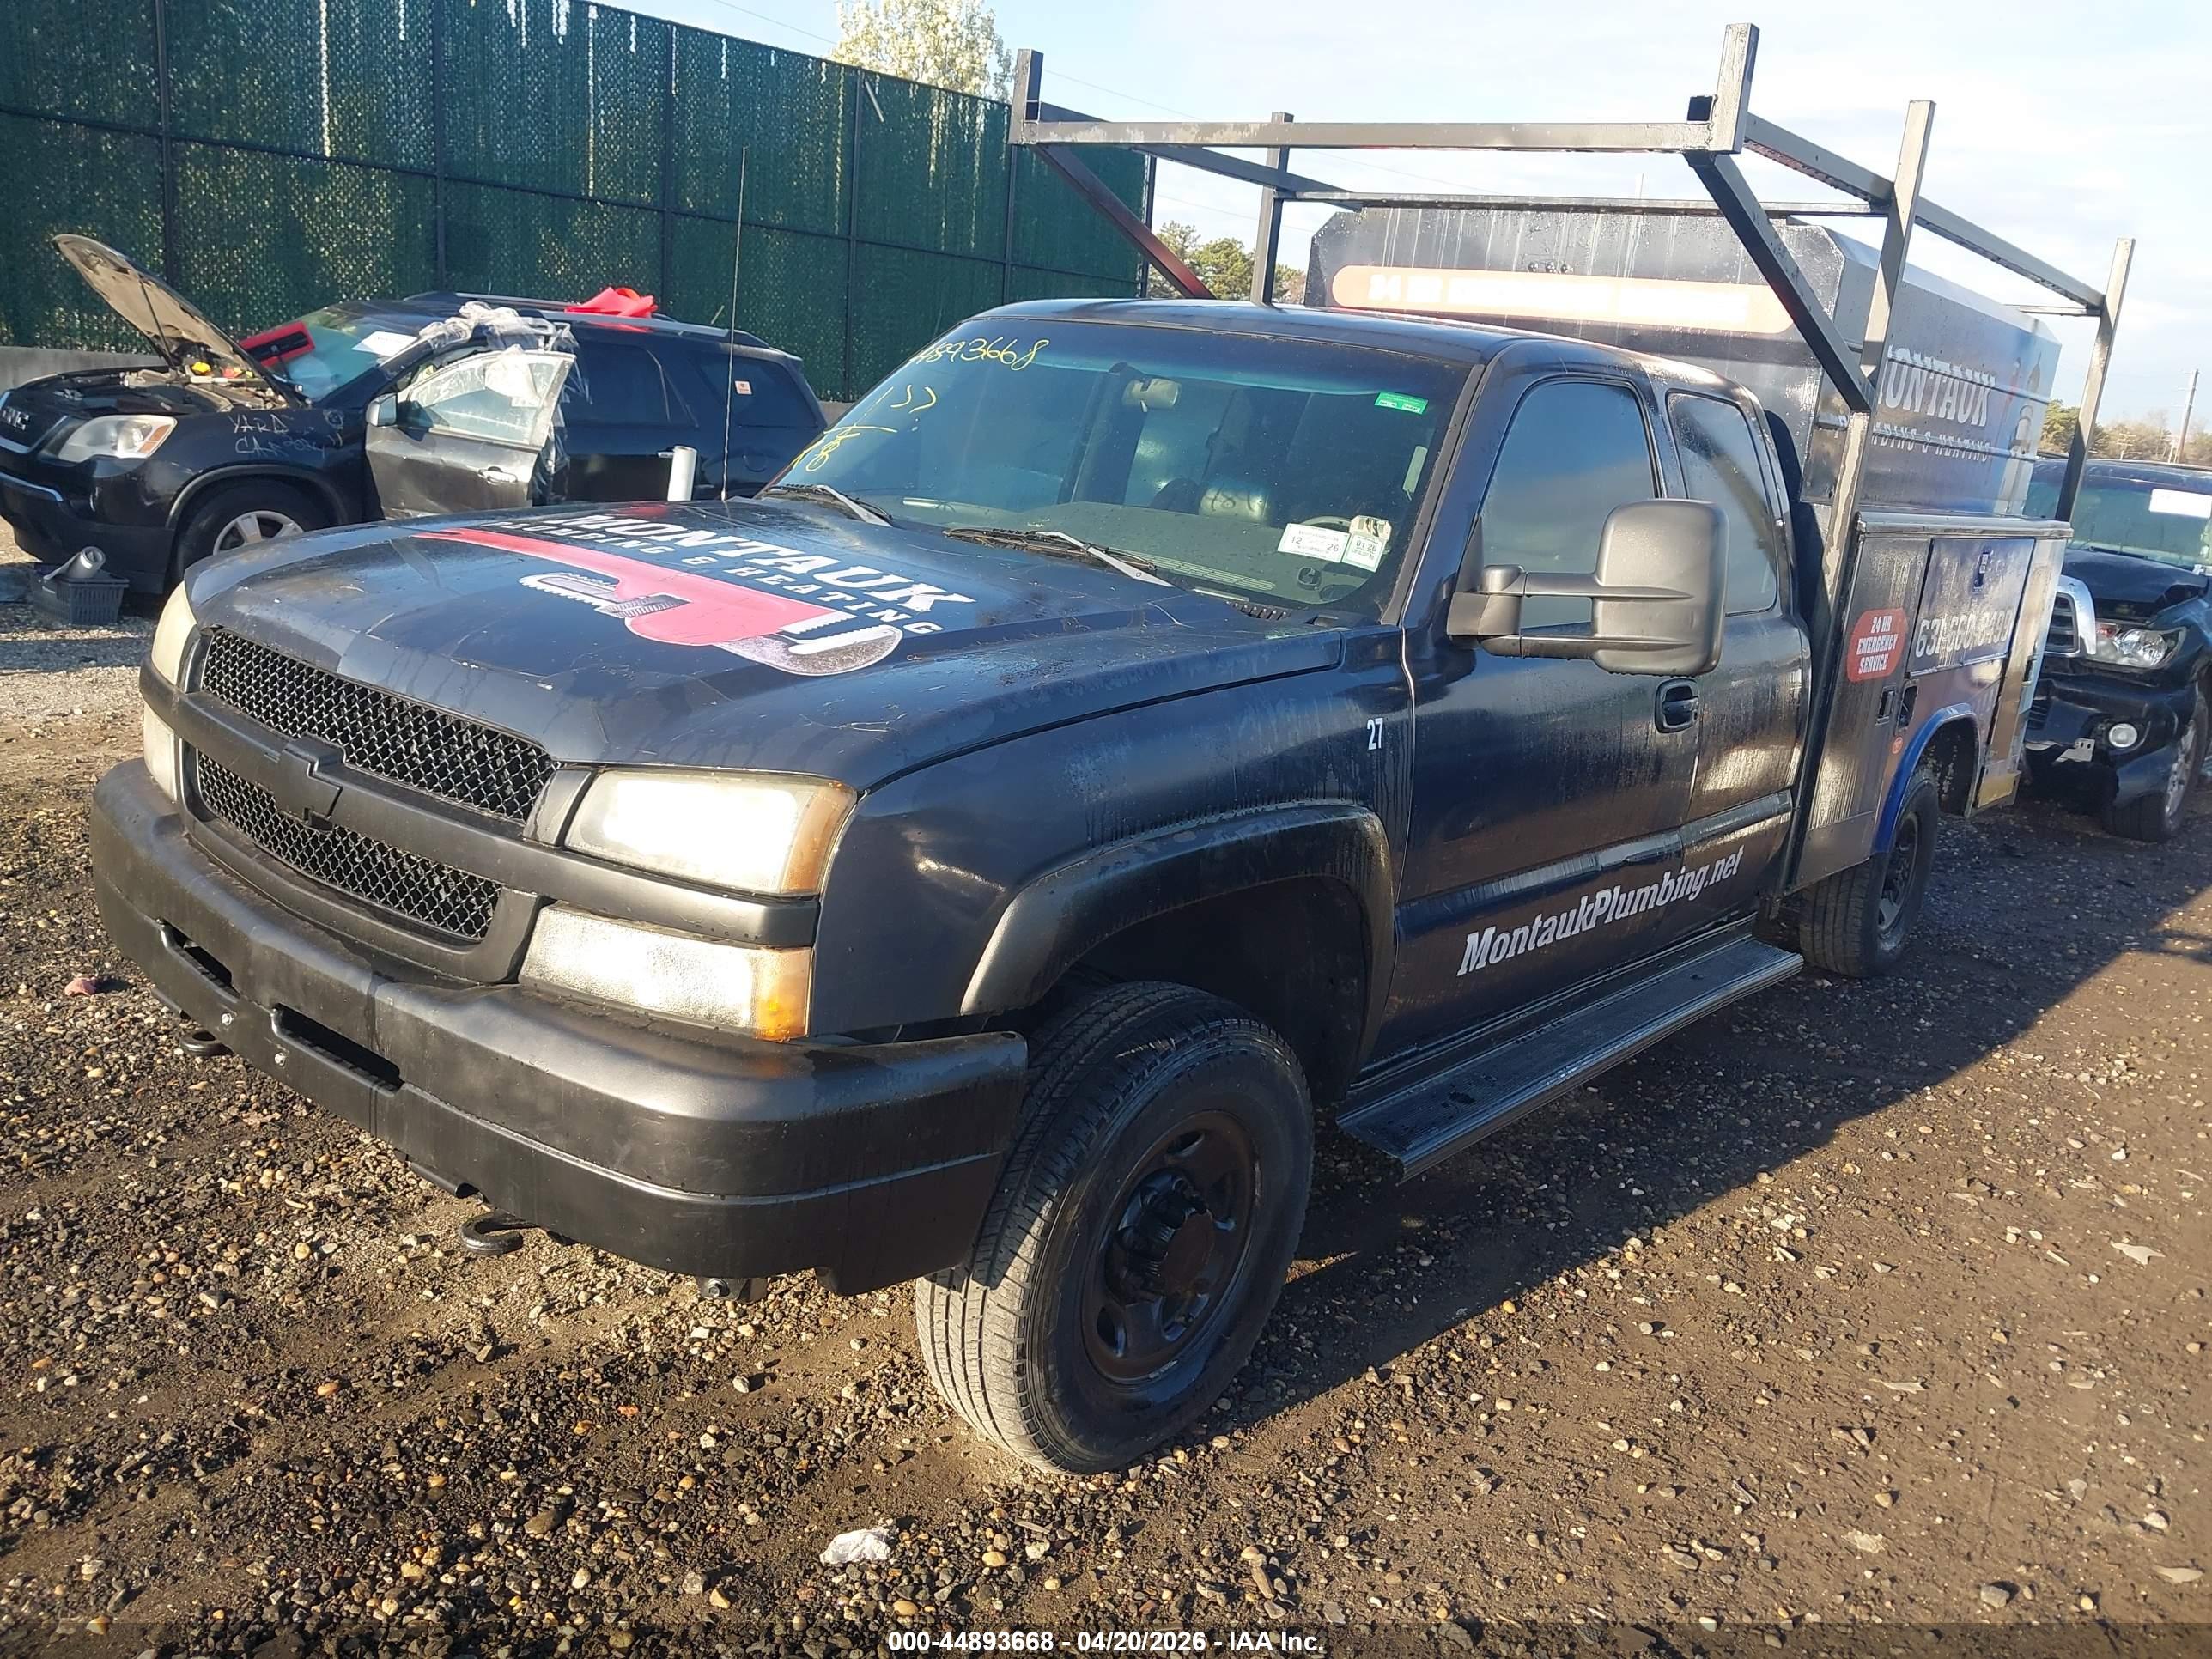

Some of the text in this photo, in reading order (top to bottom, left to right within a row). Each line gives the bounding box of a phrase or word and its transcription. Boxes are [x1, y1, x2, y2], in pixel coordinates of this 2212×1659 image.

[480, 521, 677, 555] PLUMBING
[722, 566, 945, 635] HEATING
[542, 514, 977, 613] MONTAUK
[1871, 615, 1893, 634] 24 HR
[1856, 634, 1899, 655] EMERGENCY
[1858, 653, 1889, 674] SERVICE
[1367, 718, 1383, 750] 27
[1456, 844, 1745, 976] MontaukPlumbing.net
